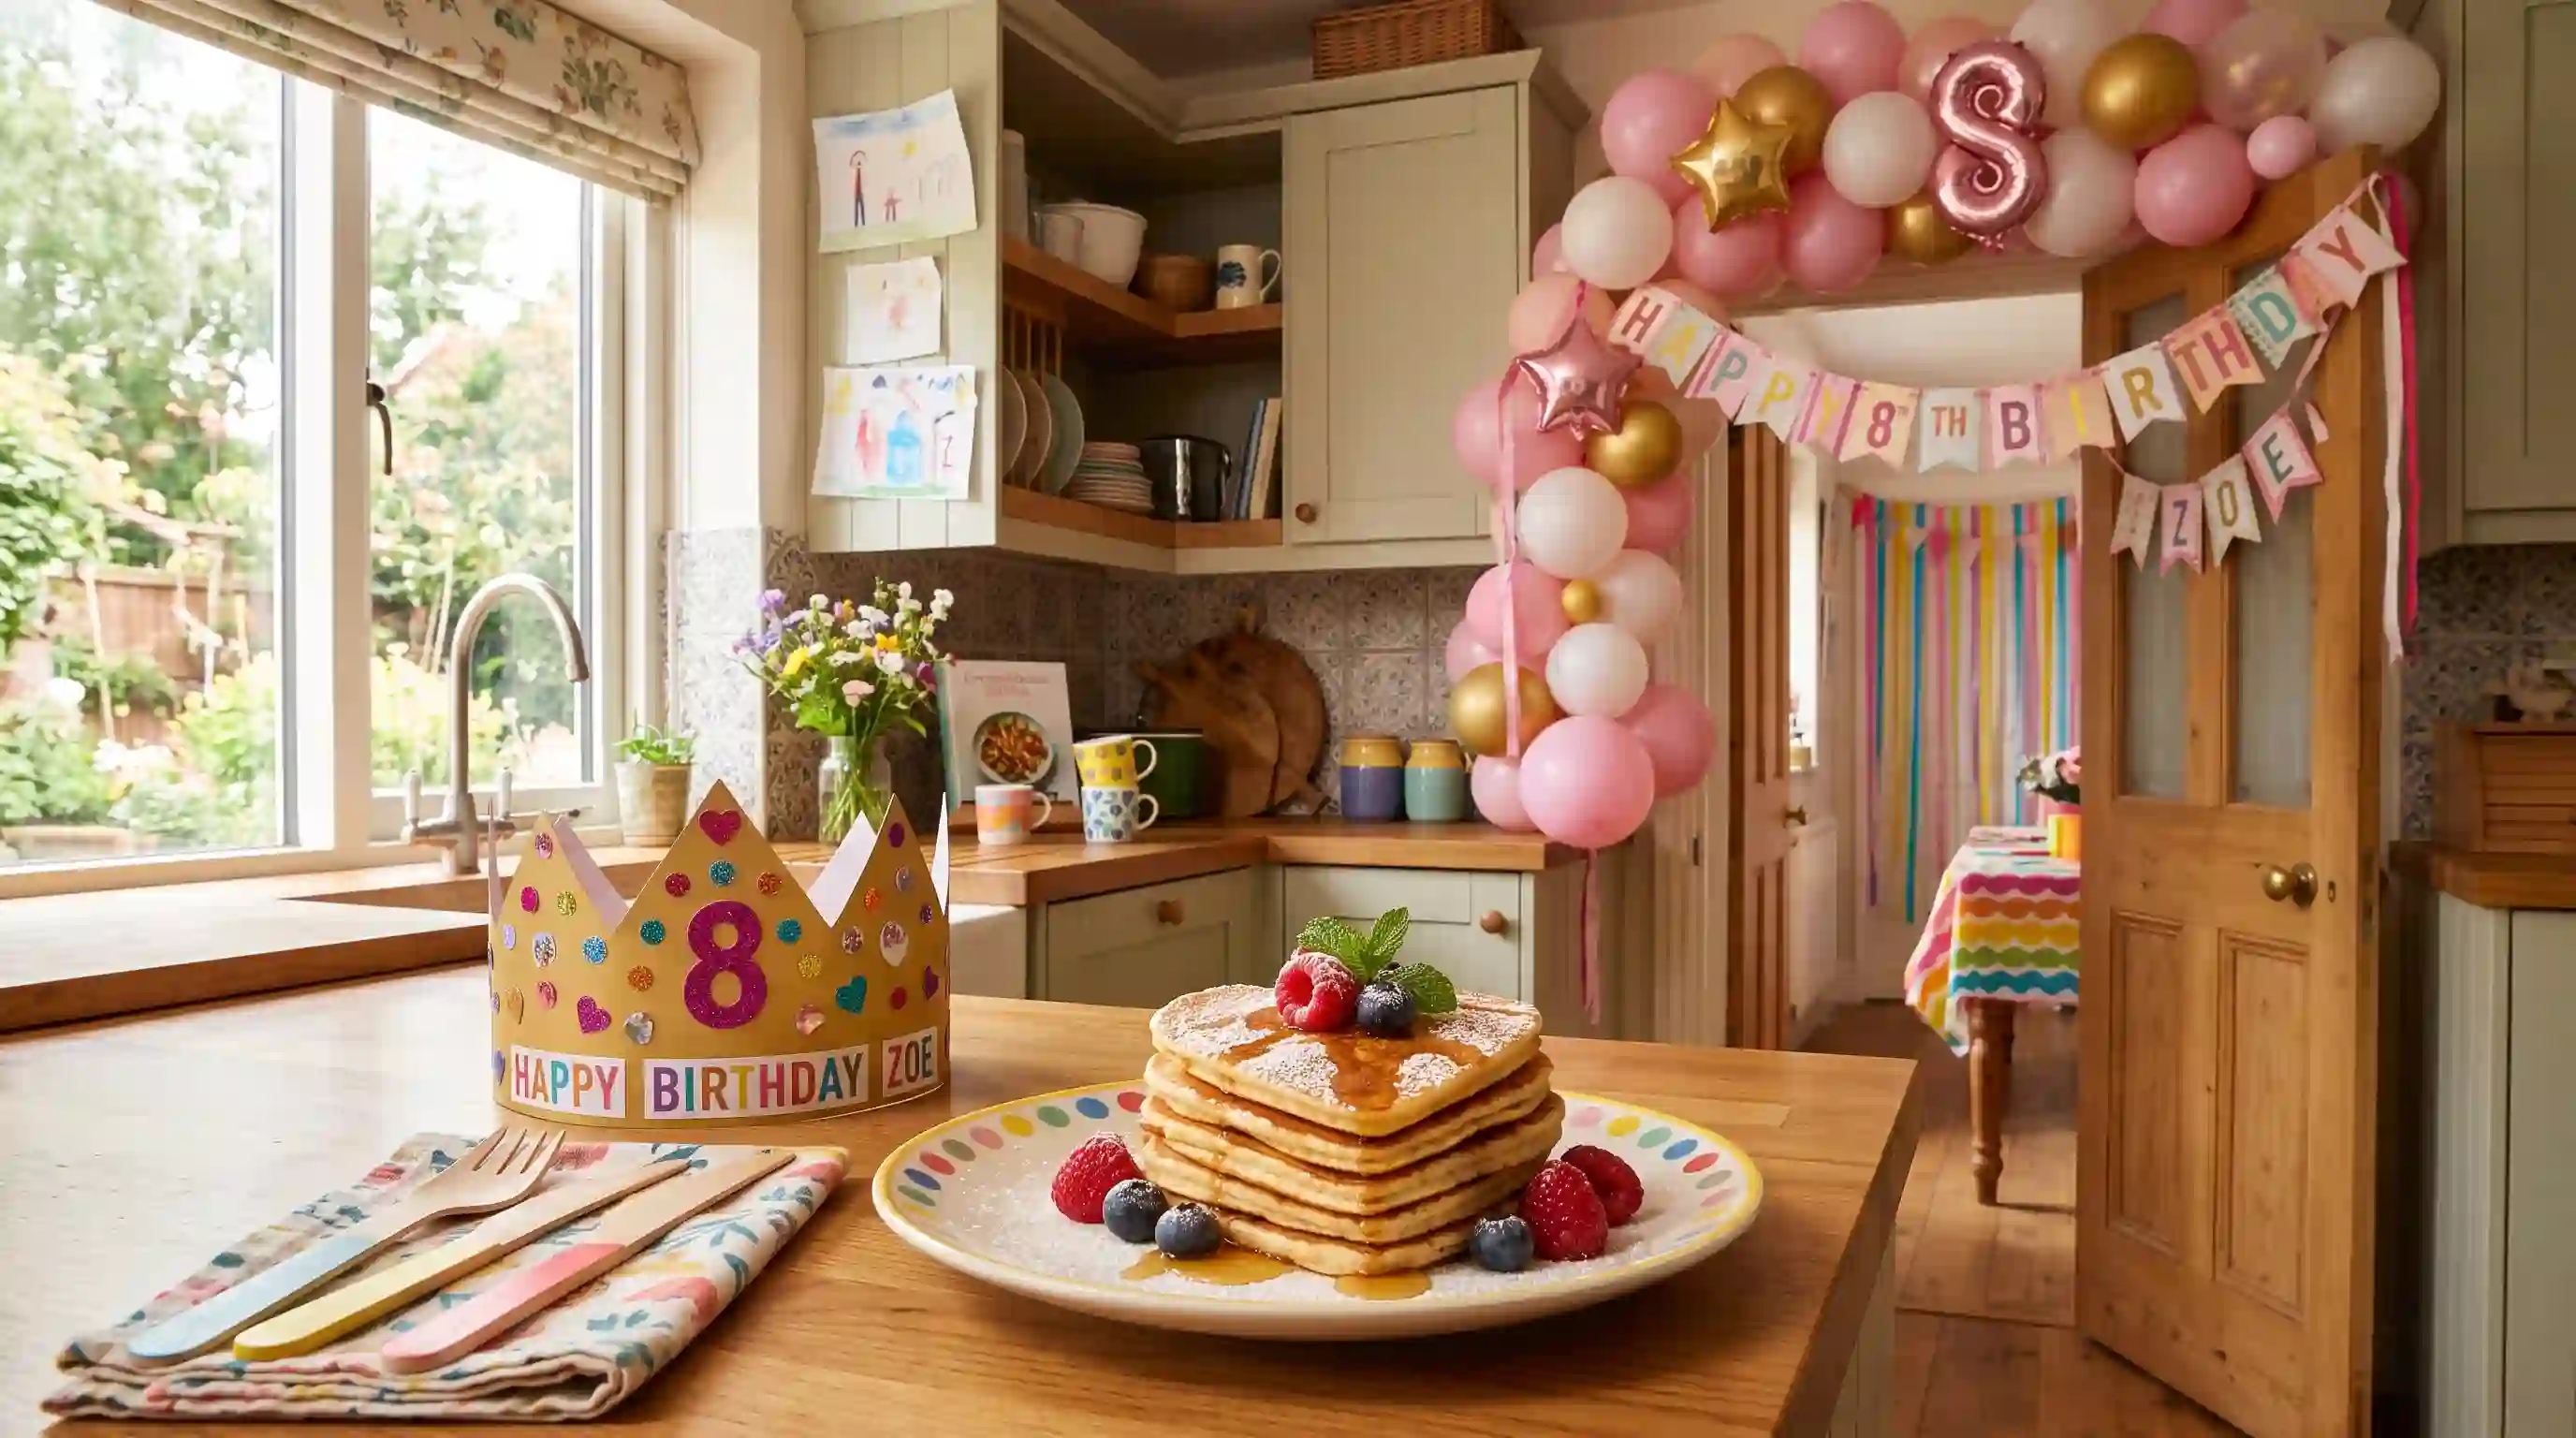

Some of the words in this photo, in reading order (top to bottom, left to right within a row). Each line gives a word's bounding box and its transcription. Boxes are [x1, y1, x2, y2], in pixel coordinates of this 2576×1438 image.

[1620, 296, 1842, 440] HAPPY
[2000, 225, 2366, 451] BIRTHDY
[2173, 432, 2294, 547] ZOE
[683, 900, 768, 1030] 8
[515, 1053, 619, 1110] HAPPY
[653, 1052, 864, 1112] BIRTHDAY
[887, 1034, 933, 1089] ZOE
